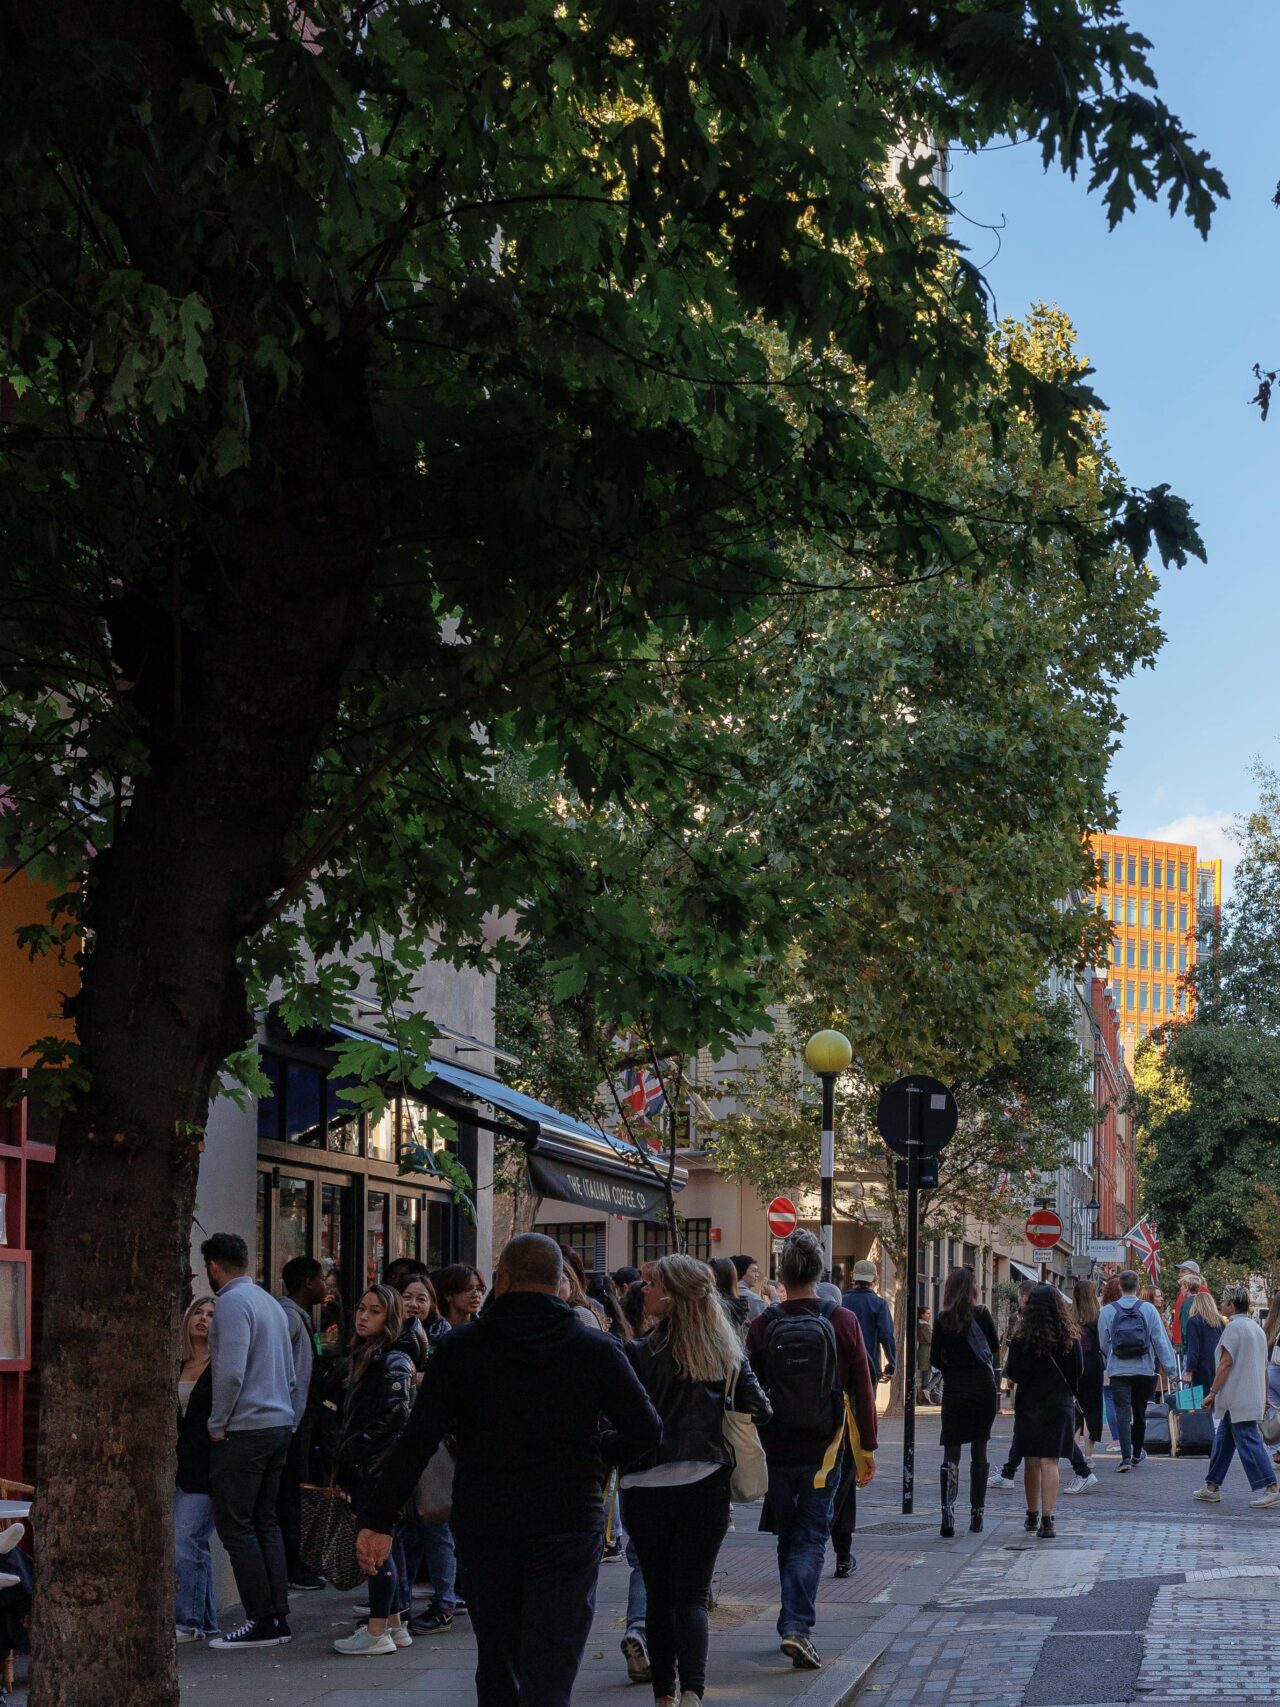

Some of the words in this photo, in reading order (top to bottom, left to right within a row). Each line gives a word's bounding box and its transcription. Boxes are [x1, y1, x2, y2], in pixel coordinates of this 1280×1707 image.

[567, 1174, 582, 1196] THE
[583, 1178, 611, 1202] ITALIAN
[612, 1186, 637, 1208] COFFEE
